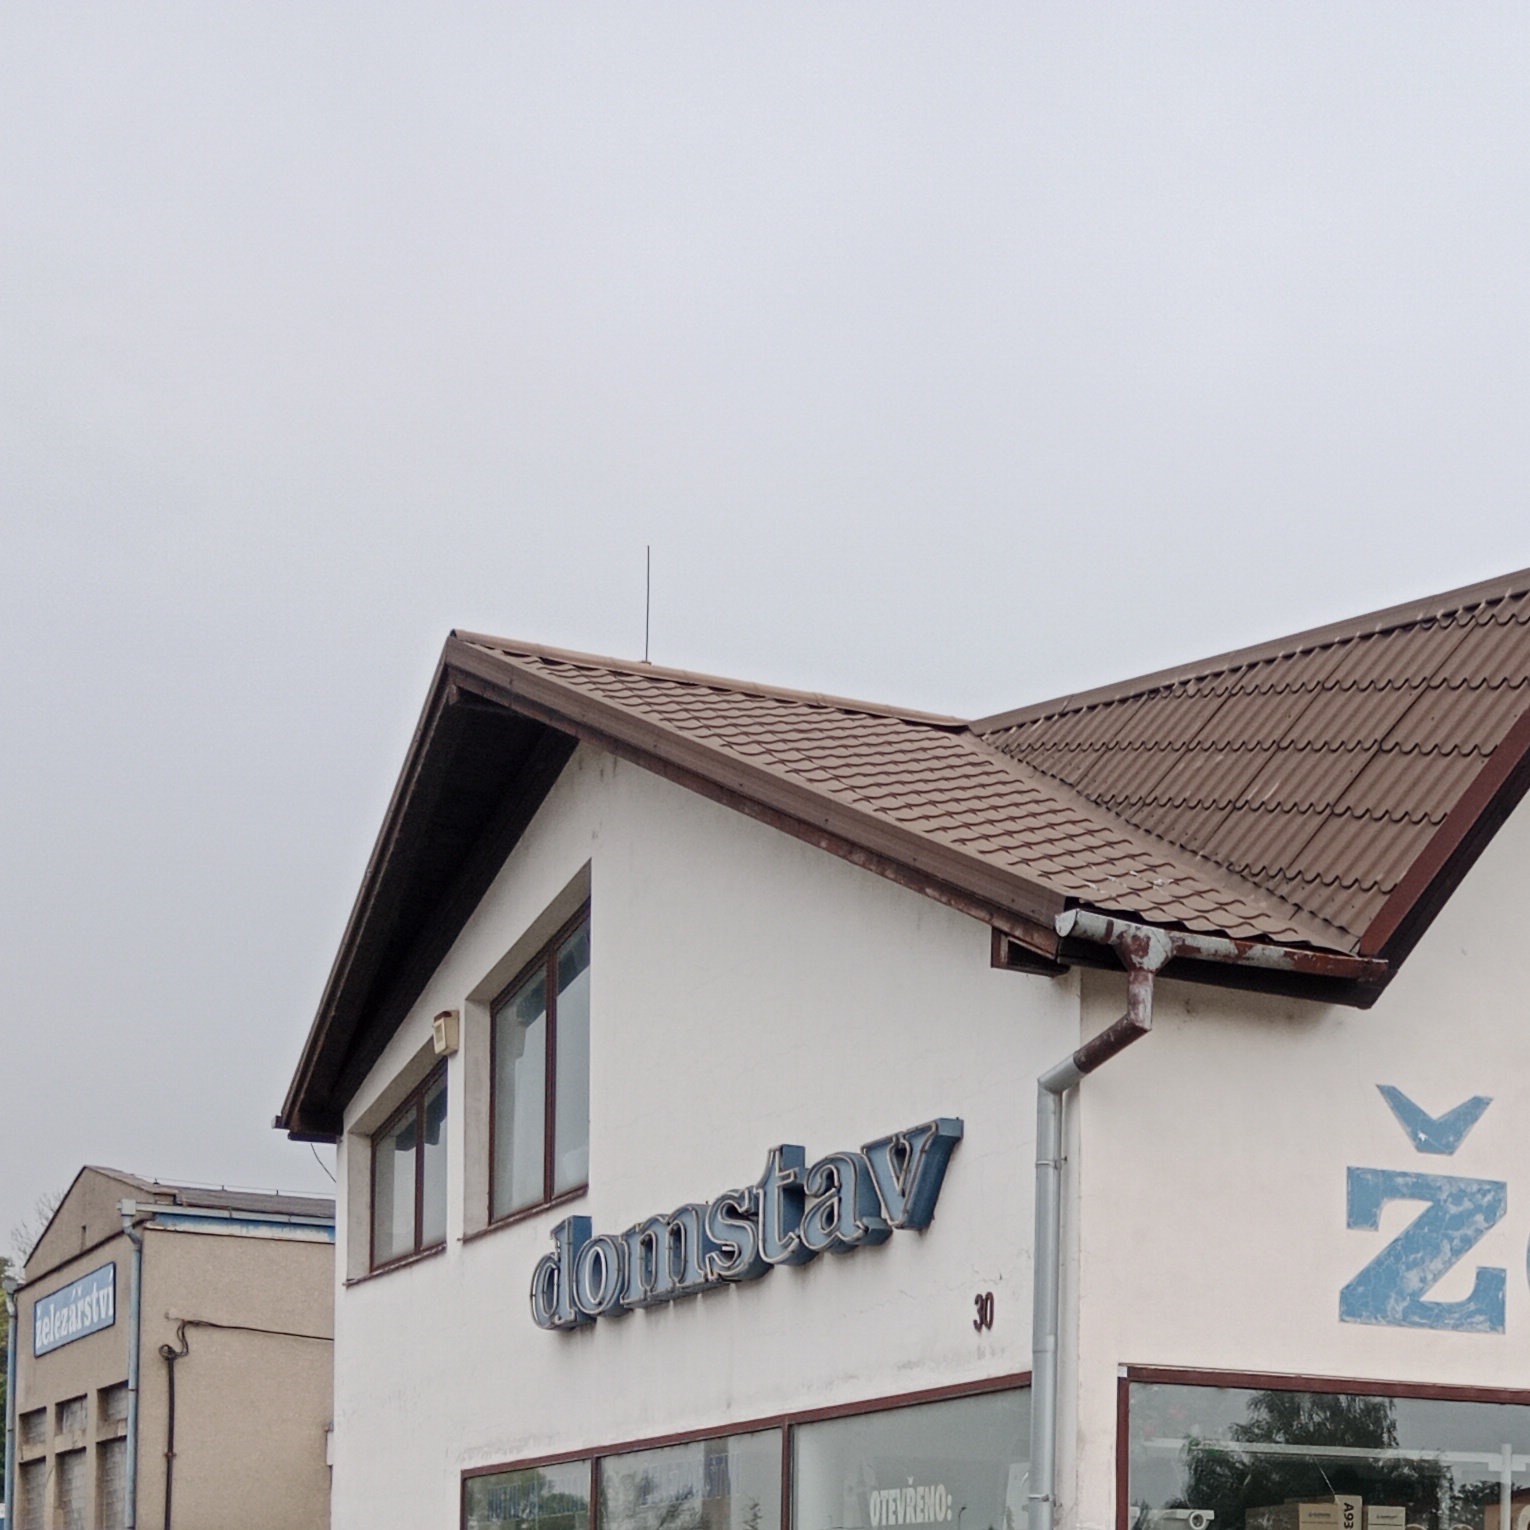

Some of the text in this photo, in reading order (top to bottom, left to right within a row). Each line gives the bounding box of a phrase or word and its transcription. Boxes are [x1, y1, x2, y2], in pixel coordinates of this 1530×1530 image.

[531, 1117, 964, 1331] domstav
[35, 1268, 114, 1348] železářství
[973, 1292, 994, 1333] 30
[869, 1476, 953, 1527] OTEVŘENO:
[1343, 1502, 1355, 1530] A93
